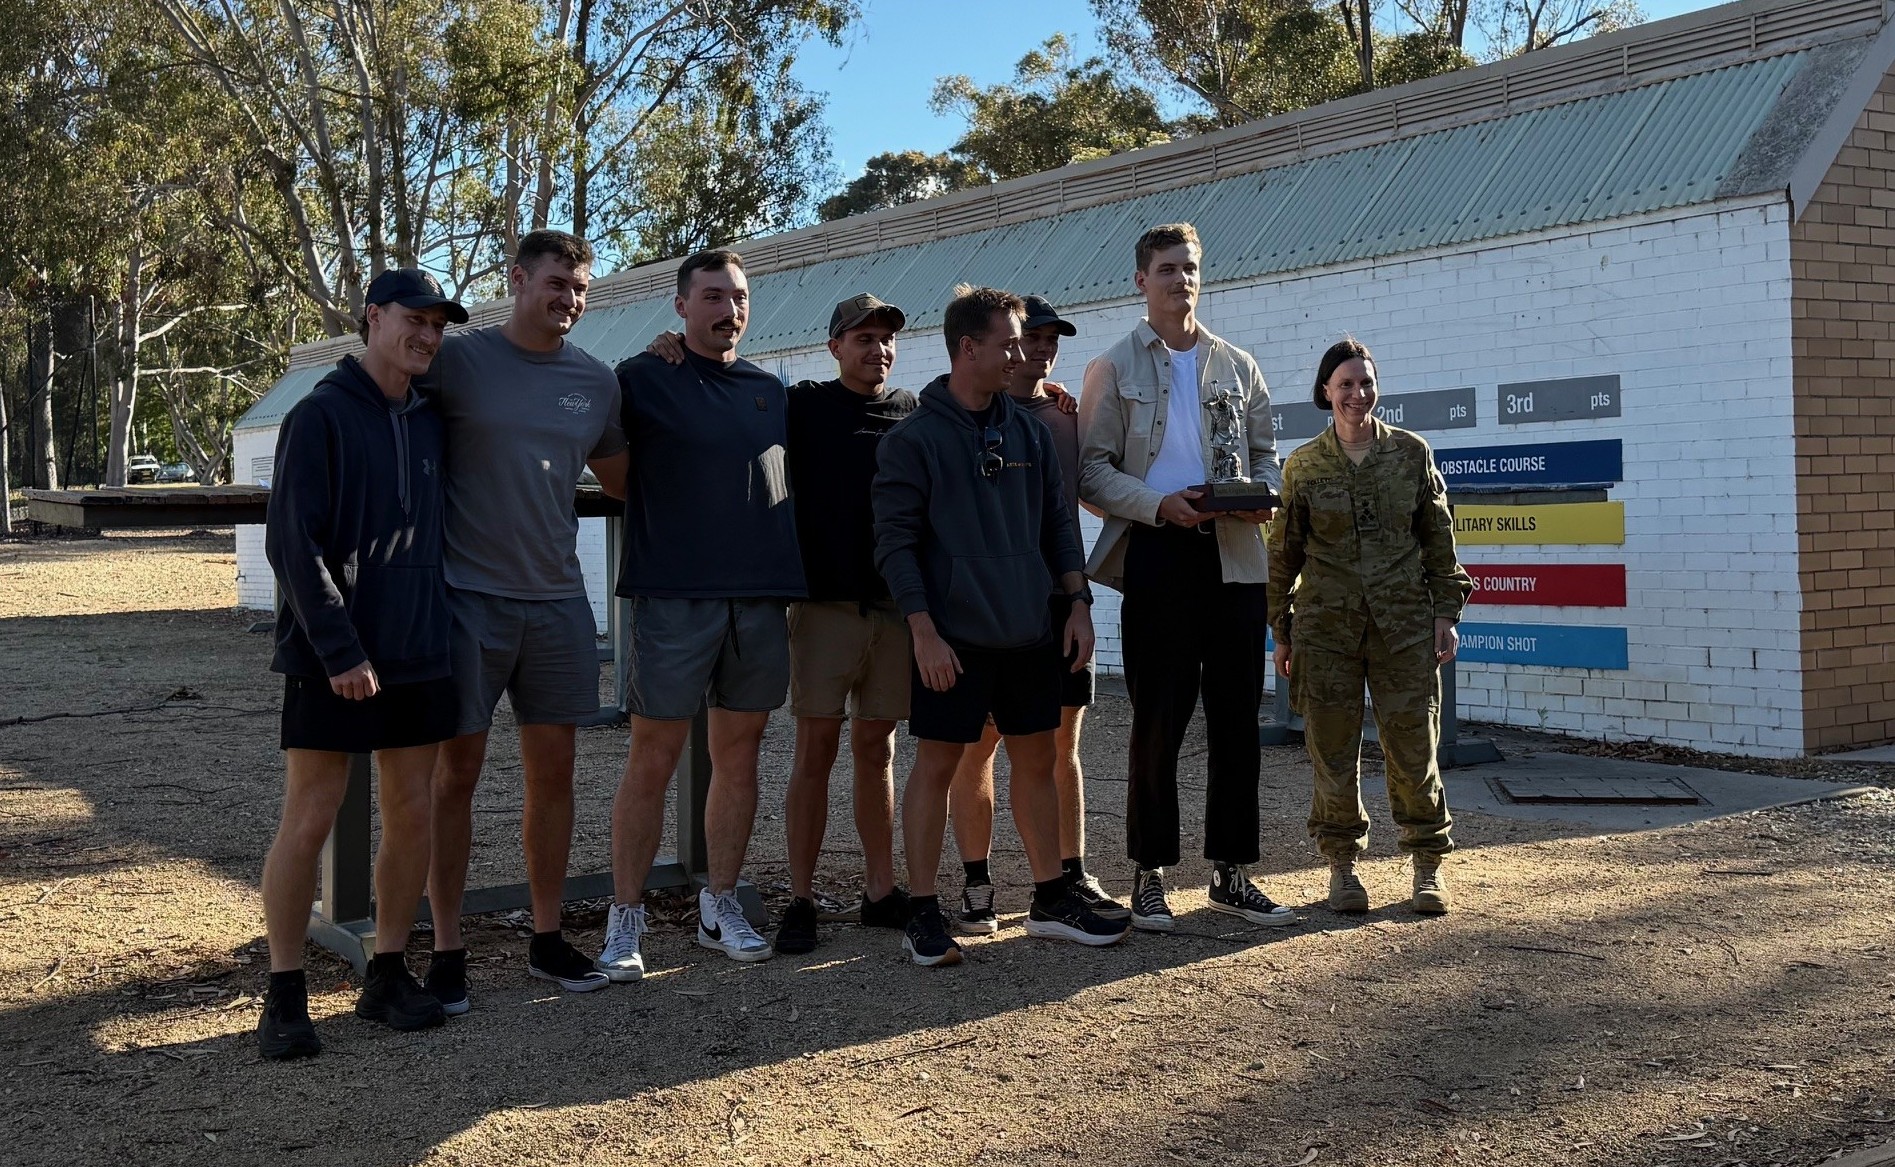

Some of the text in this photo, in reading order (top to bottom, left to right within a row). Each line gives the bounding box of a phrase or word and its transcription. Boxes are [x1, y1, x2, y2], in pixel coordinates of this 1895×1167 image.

[1507, 392, 1610, 413] 3rd pts
[1271, 413, 1283, 431] st
[1377, 404, 1467, 423] 2nd pts
[1441, 456, 1546, 475] OBSTACLE COURSE
[1453, 516, 1536, 532] ILITARY SKILLS
[1483, 576, 1537, 592] COUNTRY
[1457, 634, 1537, 652] AMPION SHOT
